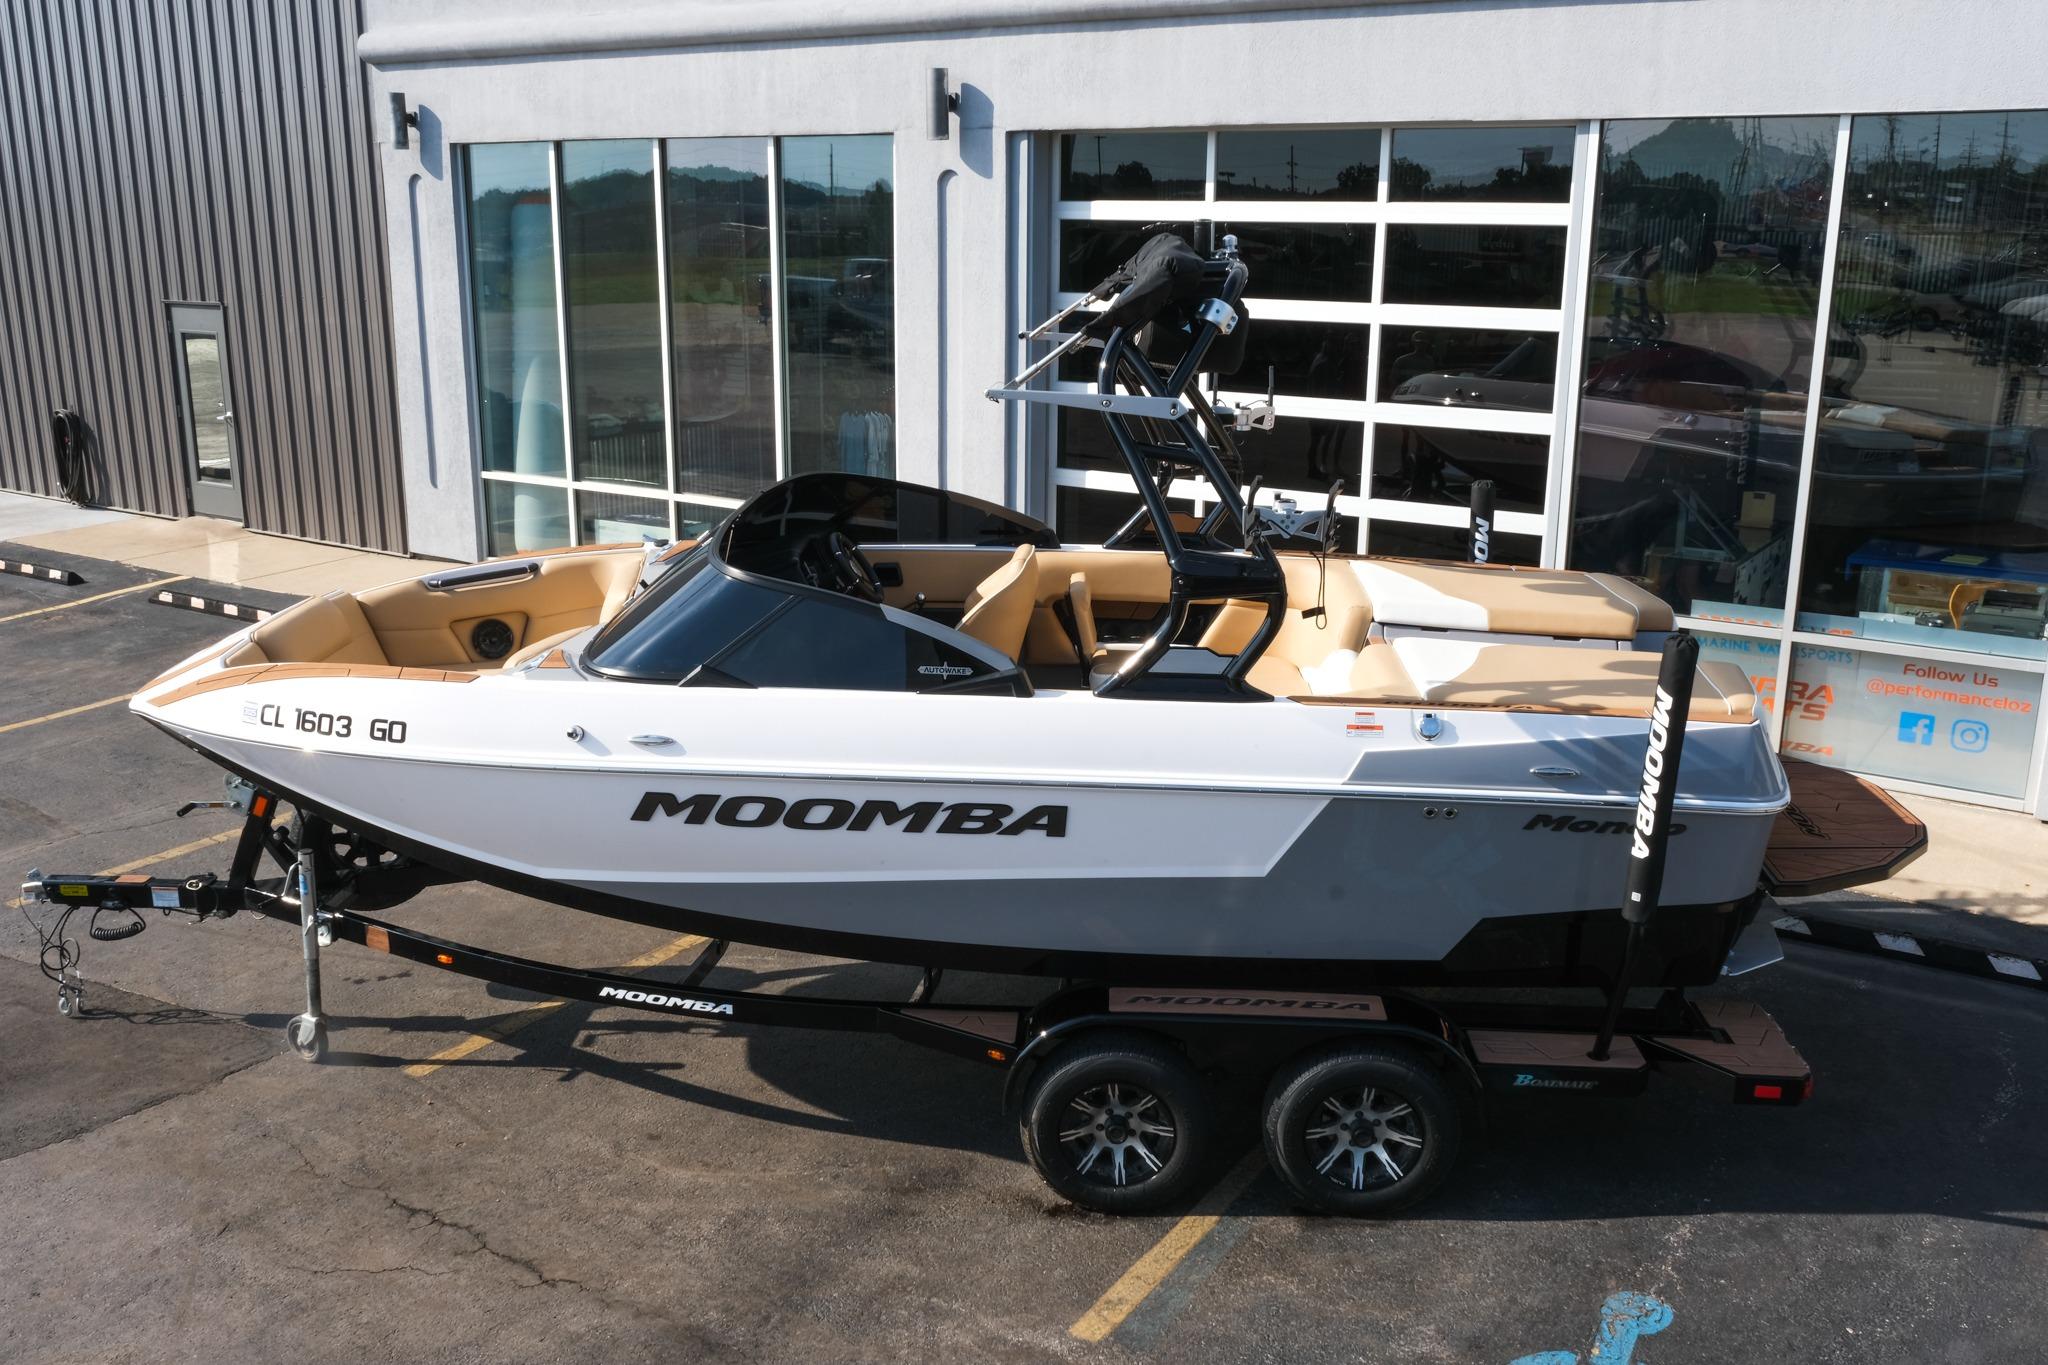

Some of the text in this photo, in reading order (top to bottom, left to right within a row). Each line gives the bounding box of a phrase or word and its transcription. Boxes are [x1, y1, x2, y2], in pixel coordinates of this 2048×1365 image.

[1474, 516, 1490, 564] MO
[923, 666, 967, 675] AUTOWAKE
[1903, 663, 1999, 688] Follow Us
[1866, 678, 2032, 713] @performanceloz
[260, 704, 285, 728] CL
[295, 708, 352, 738] 1603
[1631, 684, 1674, 860] MOOMBA
[630, 791, 1069, 838] MOOMBA
[1523, 814, 1687, 836] Mono
[599, 986, 734, 1015] MOOMBA
[1127, 996, 1371, 1011] MOOMBA
